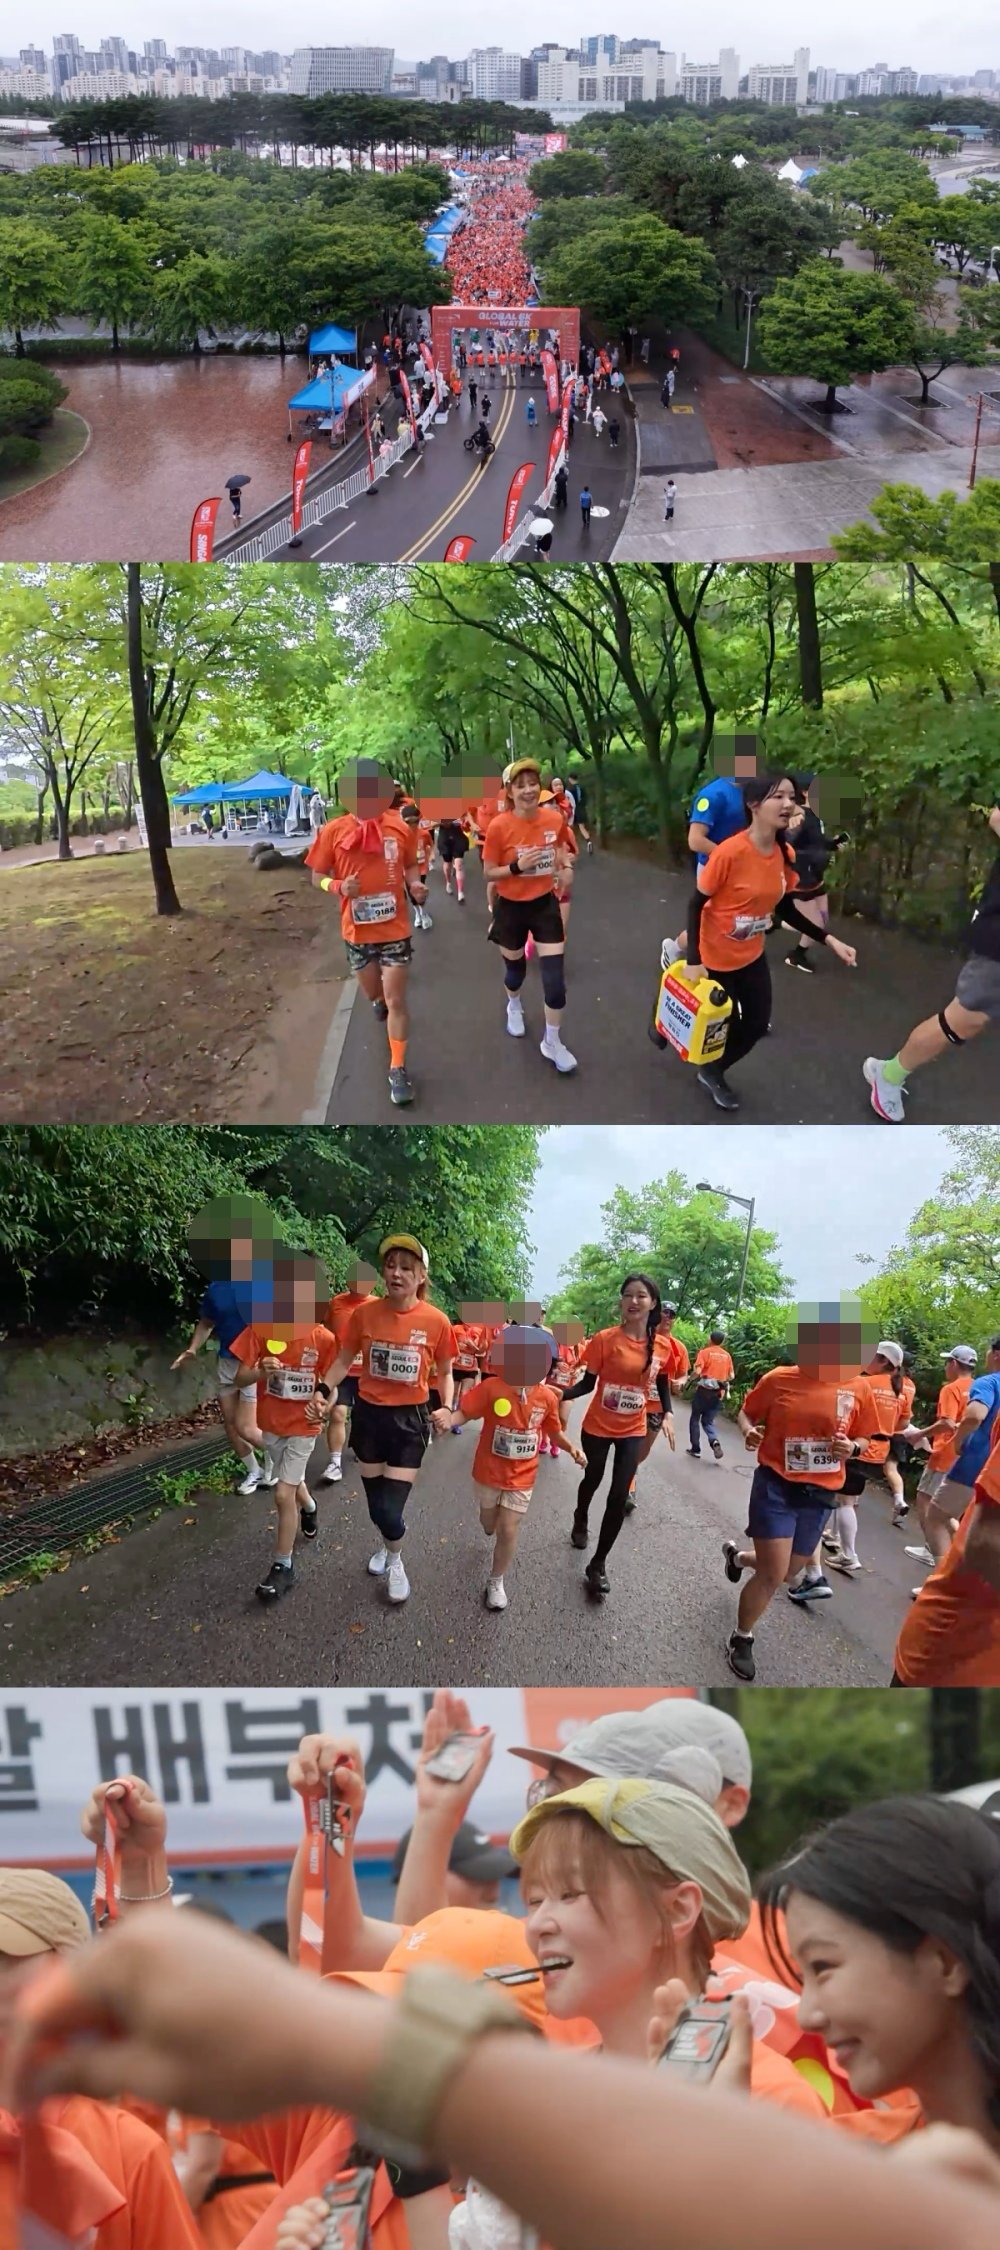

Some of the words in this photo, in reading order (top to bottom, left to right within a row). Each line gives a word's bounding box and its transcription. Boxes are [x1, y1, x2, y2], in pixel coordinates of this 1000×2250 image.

[478, 311, 517, 321] GLOBAL
[391, 1363, 418, 1374] 0003
[291, 1384, 313, 1393] 9133
